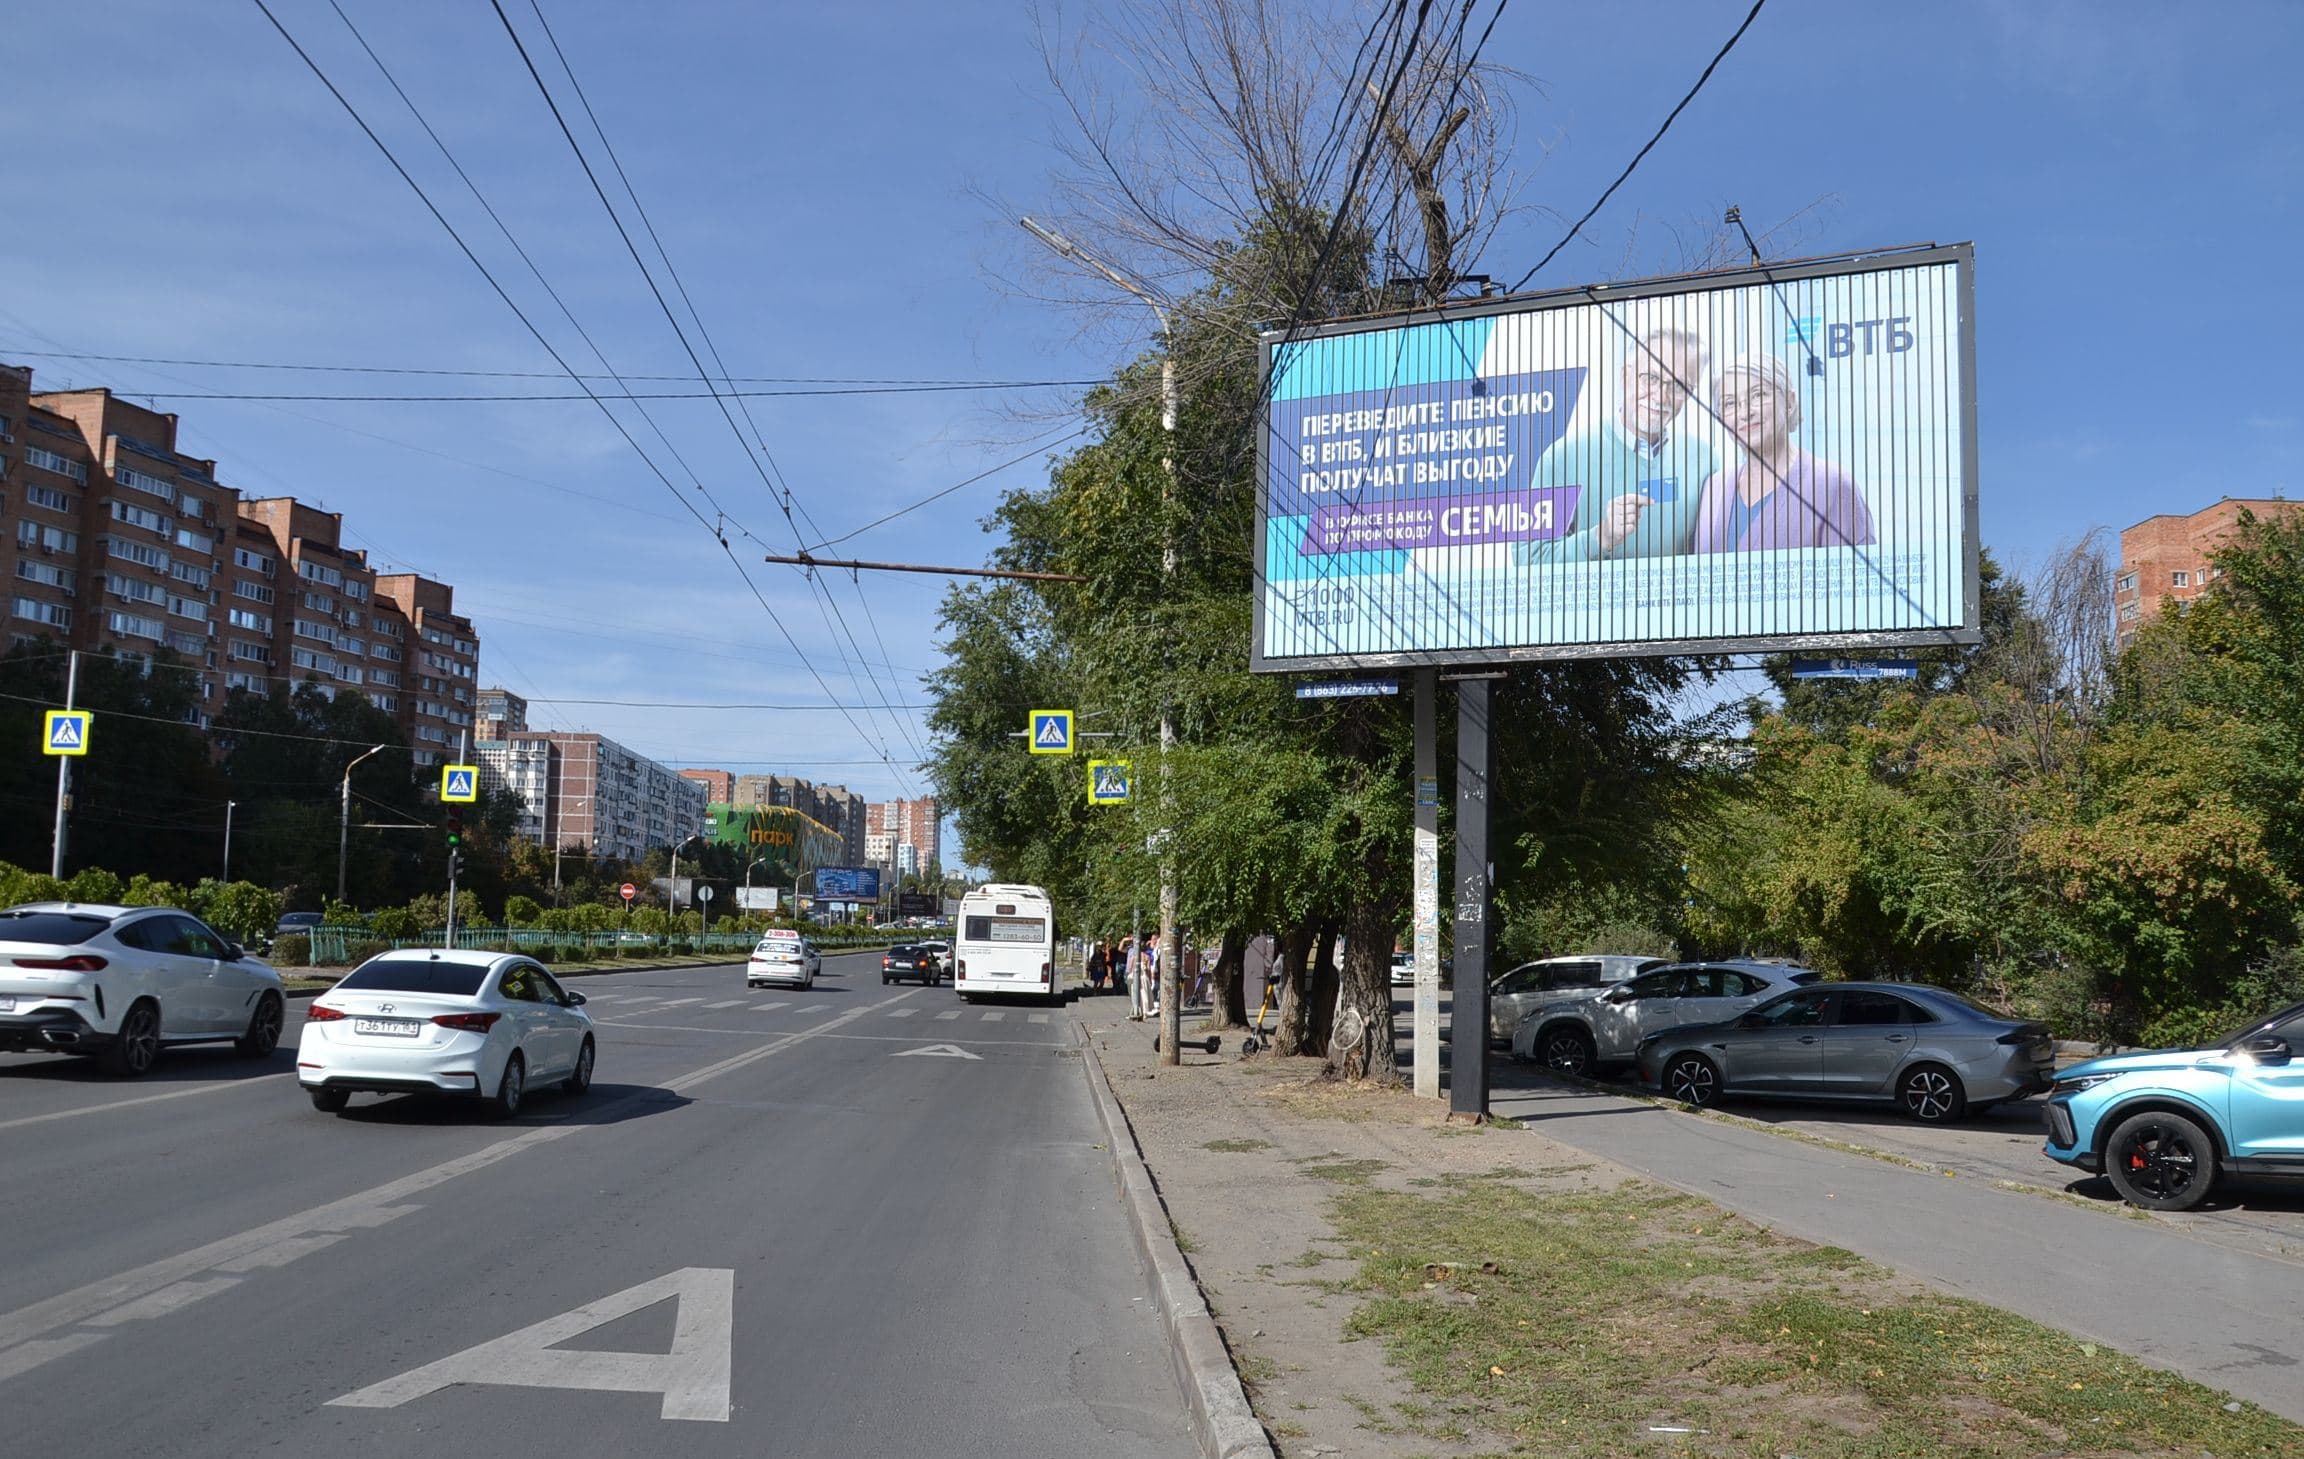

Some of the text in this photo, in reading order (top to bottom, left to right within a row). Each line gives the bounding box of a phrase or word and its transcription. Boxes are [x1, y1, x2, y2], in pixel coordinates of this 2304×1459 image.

[1828, 316, 1914, 359] ВТБ
[1302, 390, 1554, 437] ПЕРЕВЕДИТЕ ПЕНСИЮ
[1302, 425, 1506, 466] В ВТБ, И БЛИЗКИЕ
[1301, 454, 1515, 494] ПОЛУЧАТ ВЫГОДУ
[1325, 509, 1434, 529] В ОФИСЕ БАНКА
[1325, 525, 1433, 545] ПО ПРОМОКОДУ
[1440, 500, 1553, 538] СЕМЬЯ
[1310, 586, 1355, 606] 1000
[1296, 607, 1354, 628] VTB.RU
